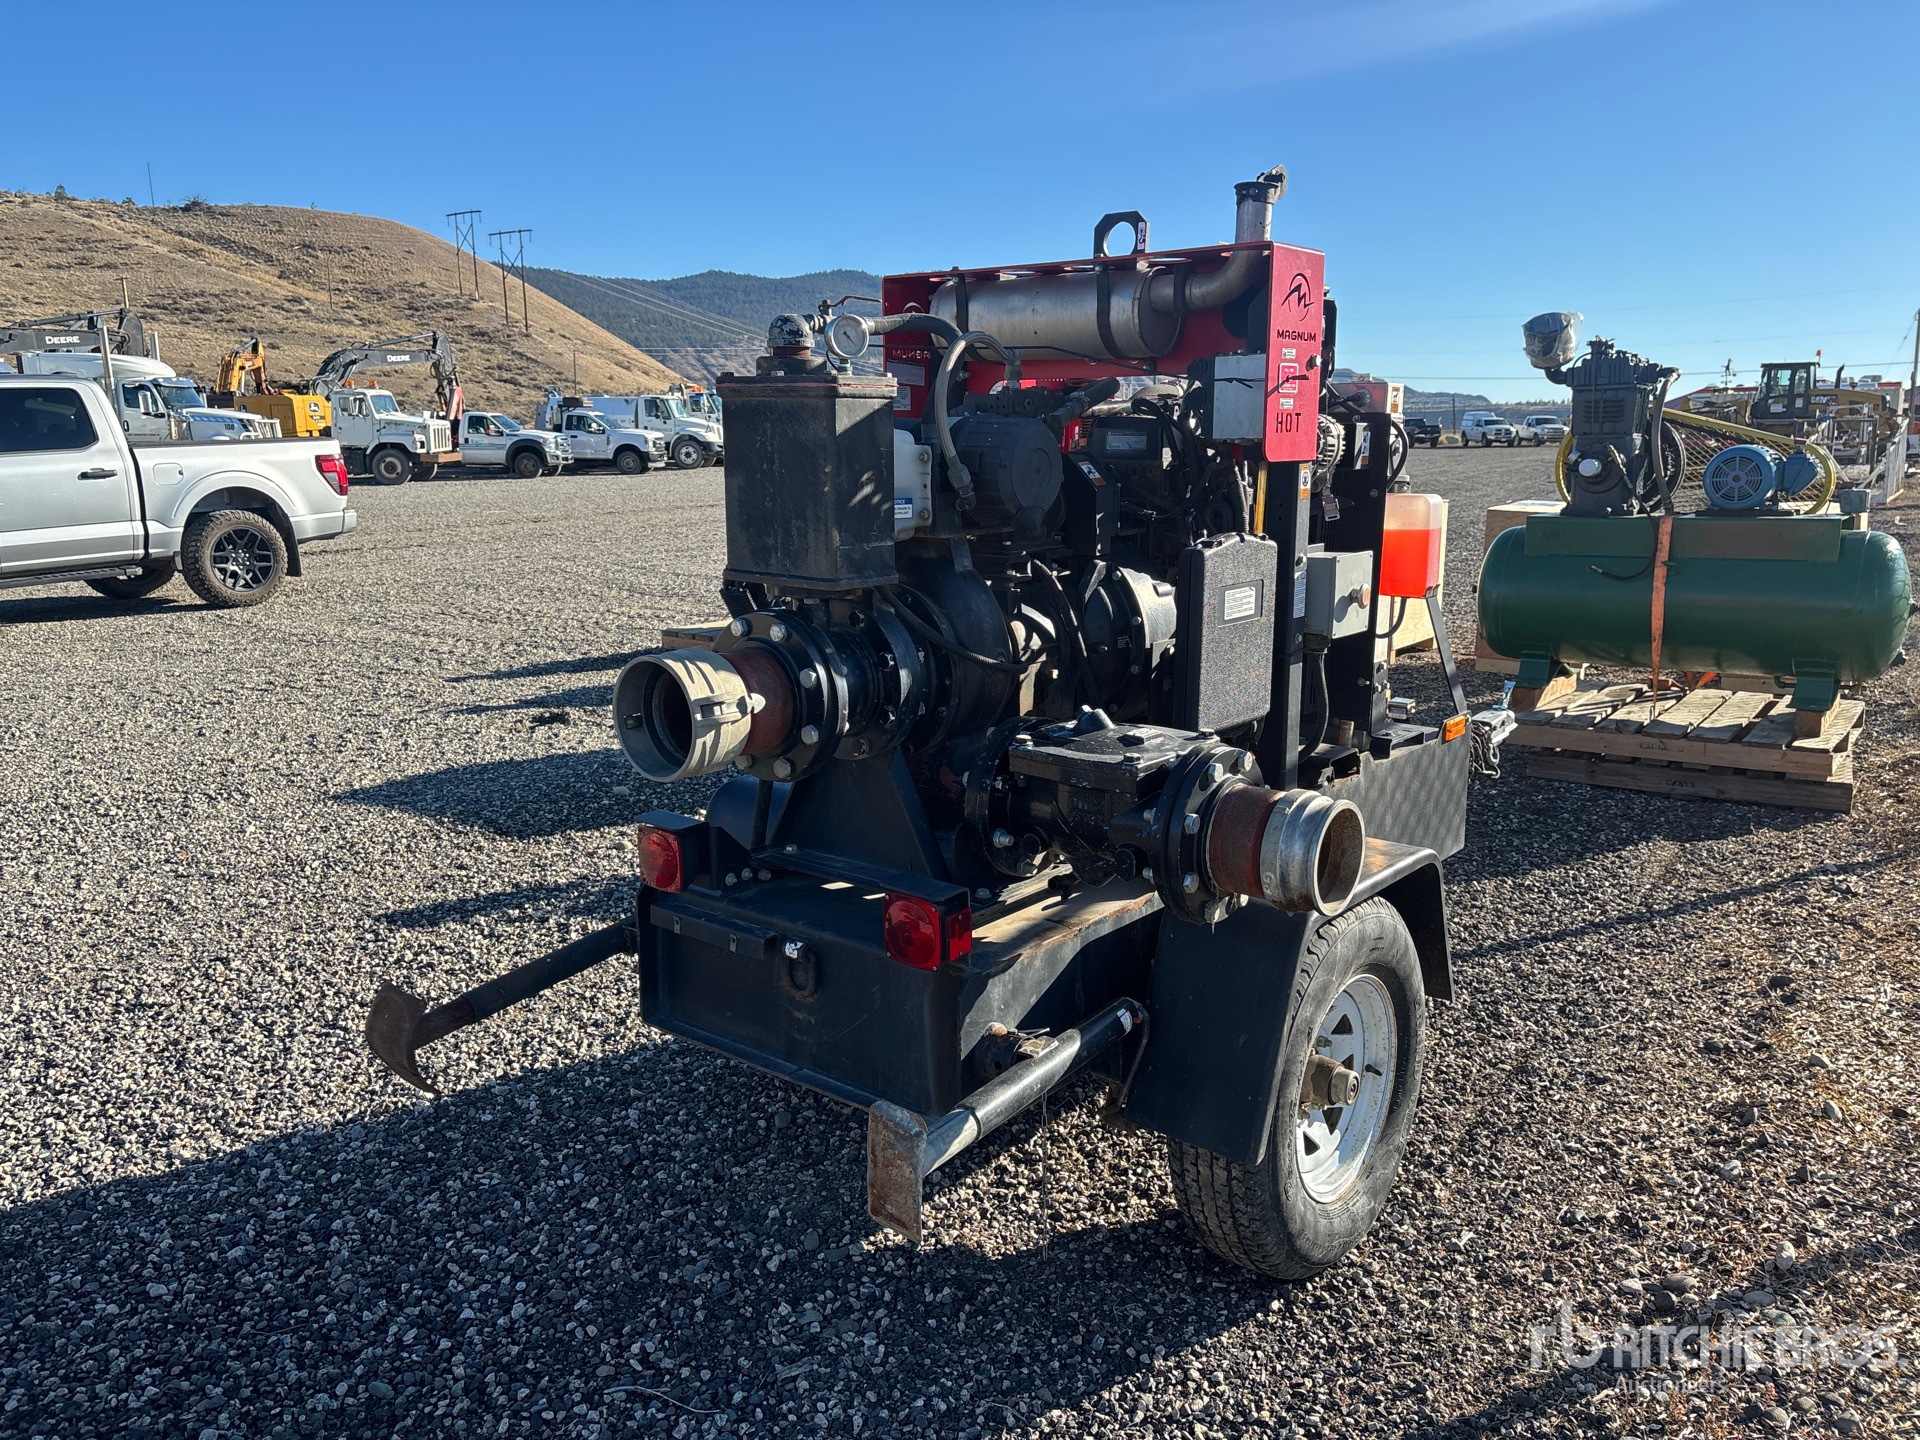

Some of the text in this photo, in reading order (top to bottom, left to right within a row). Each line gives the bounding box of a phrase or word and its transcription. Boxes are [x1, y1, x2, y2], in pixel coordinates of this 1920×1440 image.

[1276, 329, 1317, 342] MAGNUM
[45, 336, 80, 344] DEERE
[386, 354, 411, 362] DEERE
[1275, 412, 1301, 433] HOT
[224, 423, 235, 431] 108
